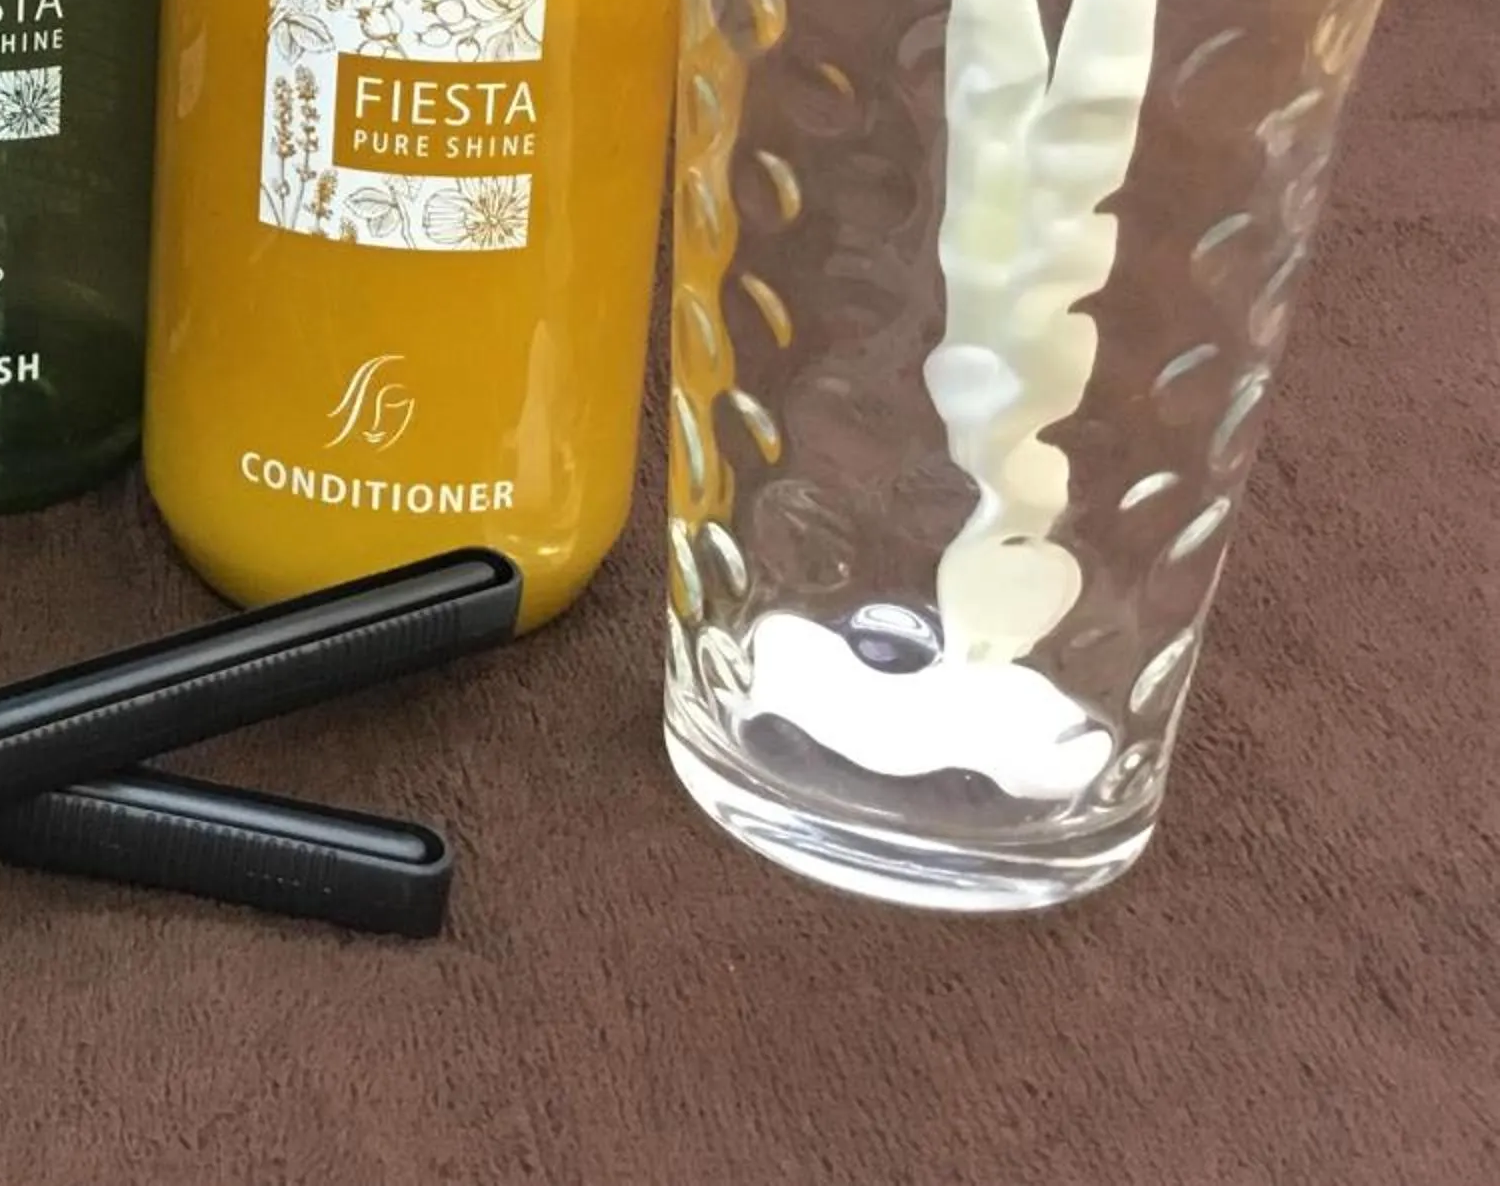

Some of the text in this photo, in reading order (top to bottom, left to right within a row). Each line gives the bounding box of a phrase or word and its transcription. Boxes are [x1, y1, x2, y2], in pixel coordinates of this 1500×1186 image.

[354, 75, 537, 125] FIESTA
[353, 129, 536, 159] PURE SHINE
[240, 450, 515, 514] CONDITIONER
